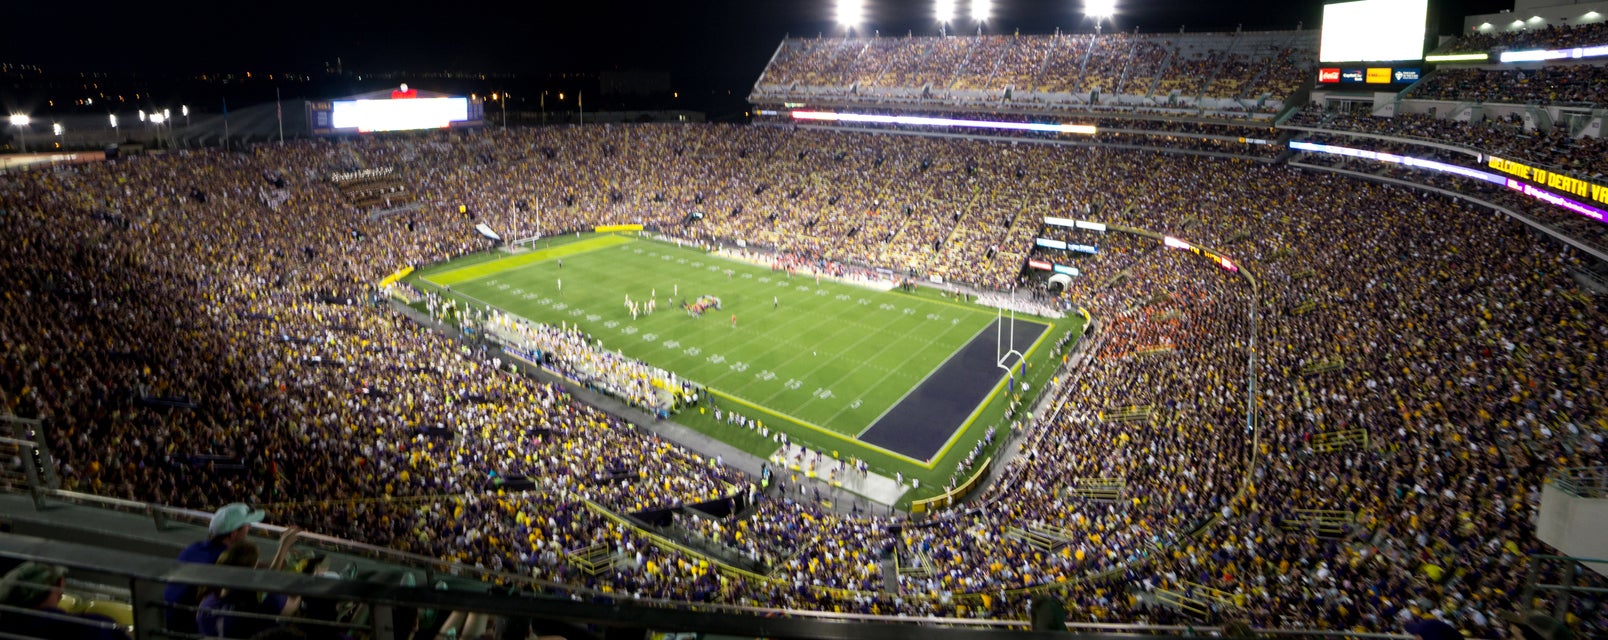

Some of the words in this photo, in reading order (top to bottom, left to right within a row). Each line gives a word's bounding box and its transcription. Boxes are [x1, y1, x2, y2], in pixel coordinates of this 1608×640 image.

[1488, 155, 1531, 179] WELCOME
[1532, 167, 1547, 185] TO
[1547, 172, 1591, 198] DEATH
